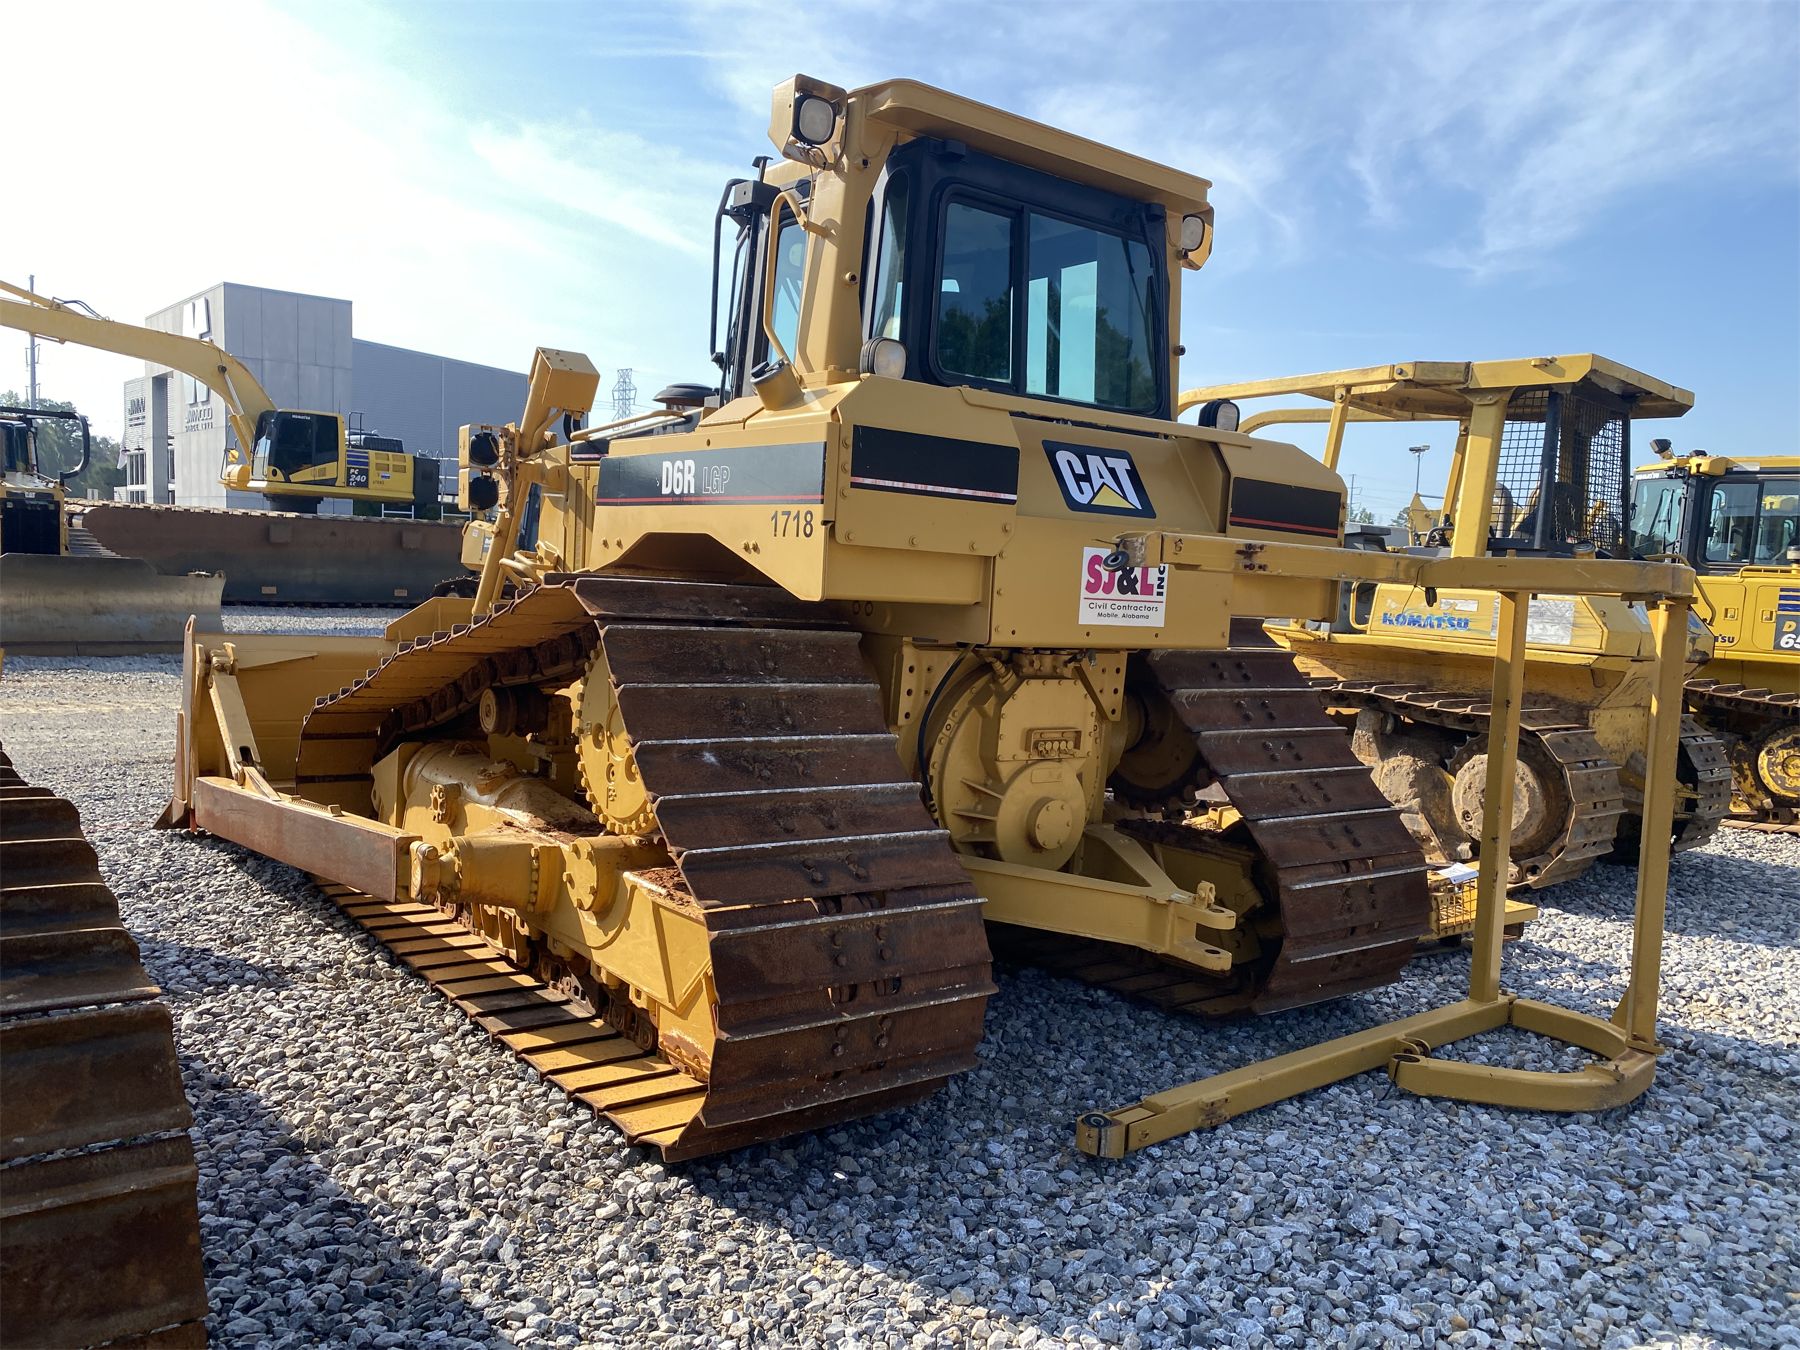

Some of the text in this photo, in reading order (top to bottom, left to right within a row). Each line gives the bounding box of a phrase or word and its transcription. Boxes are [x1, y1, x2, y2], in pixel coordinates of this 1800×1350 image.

[349, 474, 367, 483] 240
[661, 459, 730, 495] D6R LGP
[1055, 450, 1143, 510] CAT
[770, 510, 814, 538] 1718
[1088, 602, 1159, 612] Civil Contractors
[1382, 612, 1470, 631] KOMATSU
[1783, 621, 1797, 632] D
